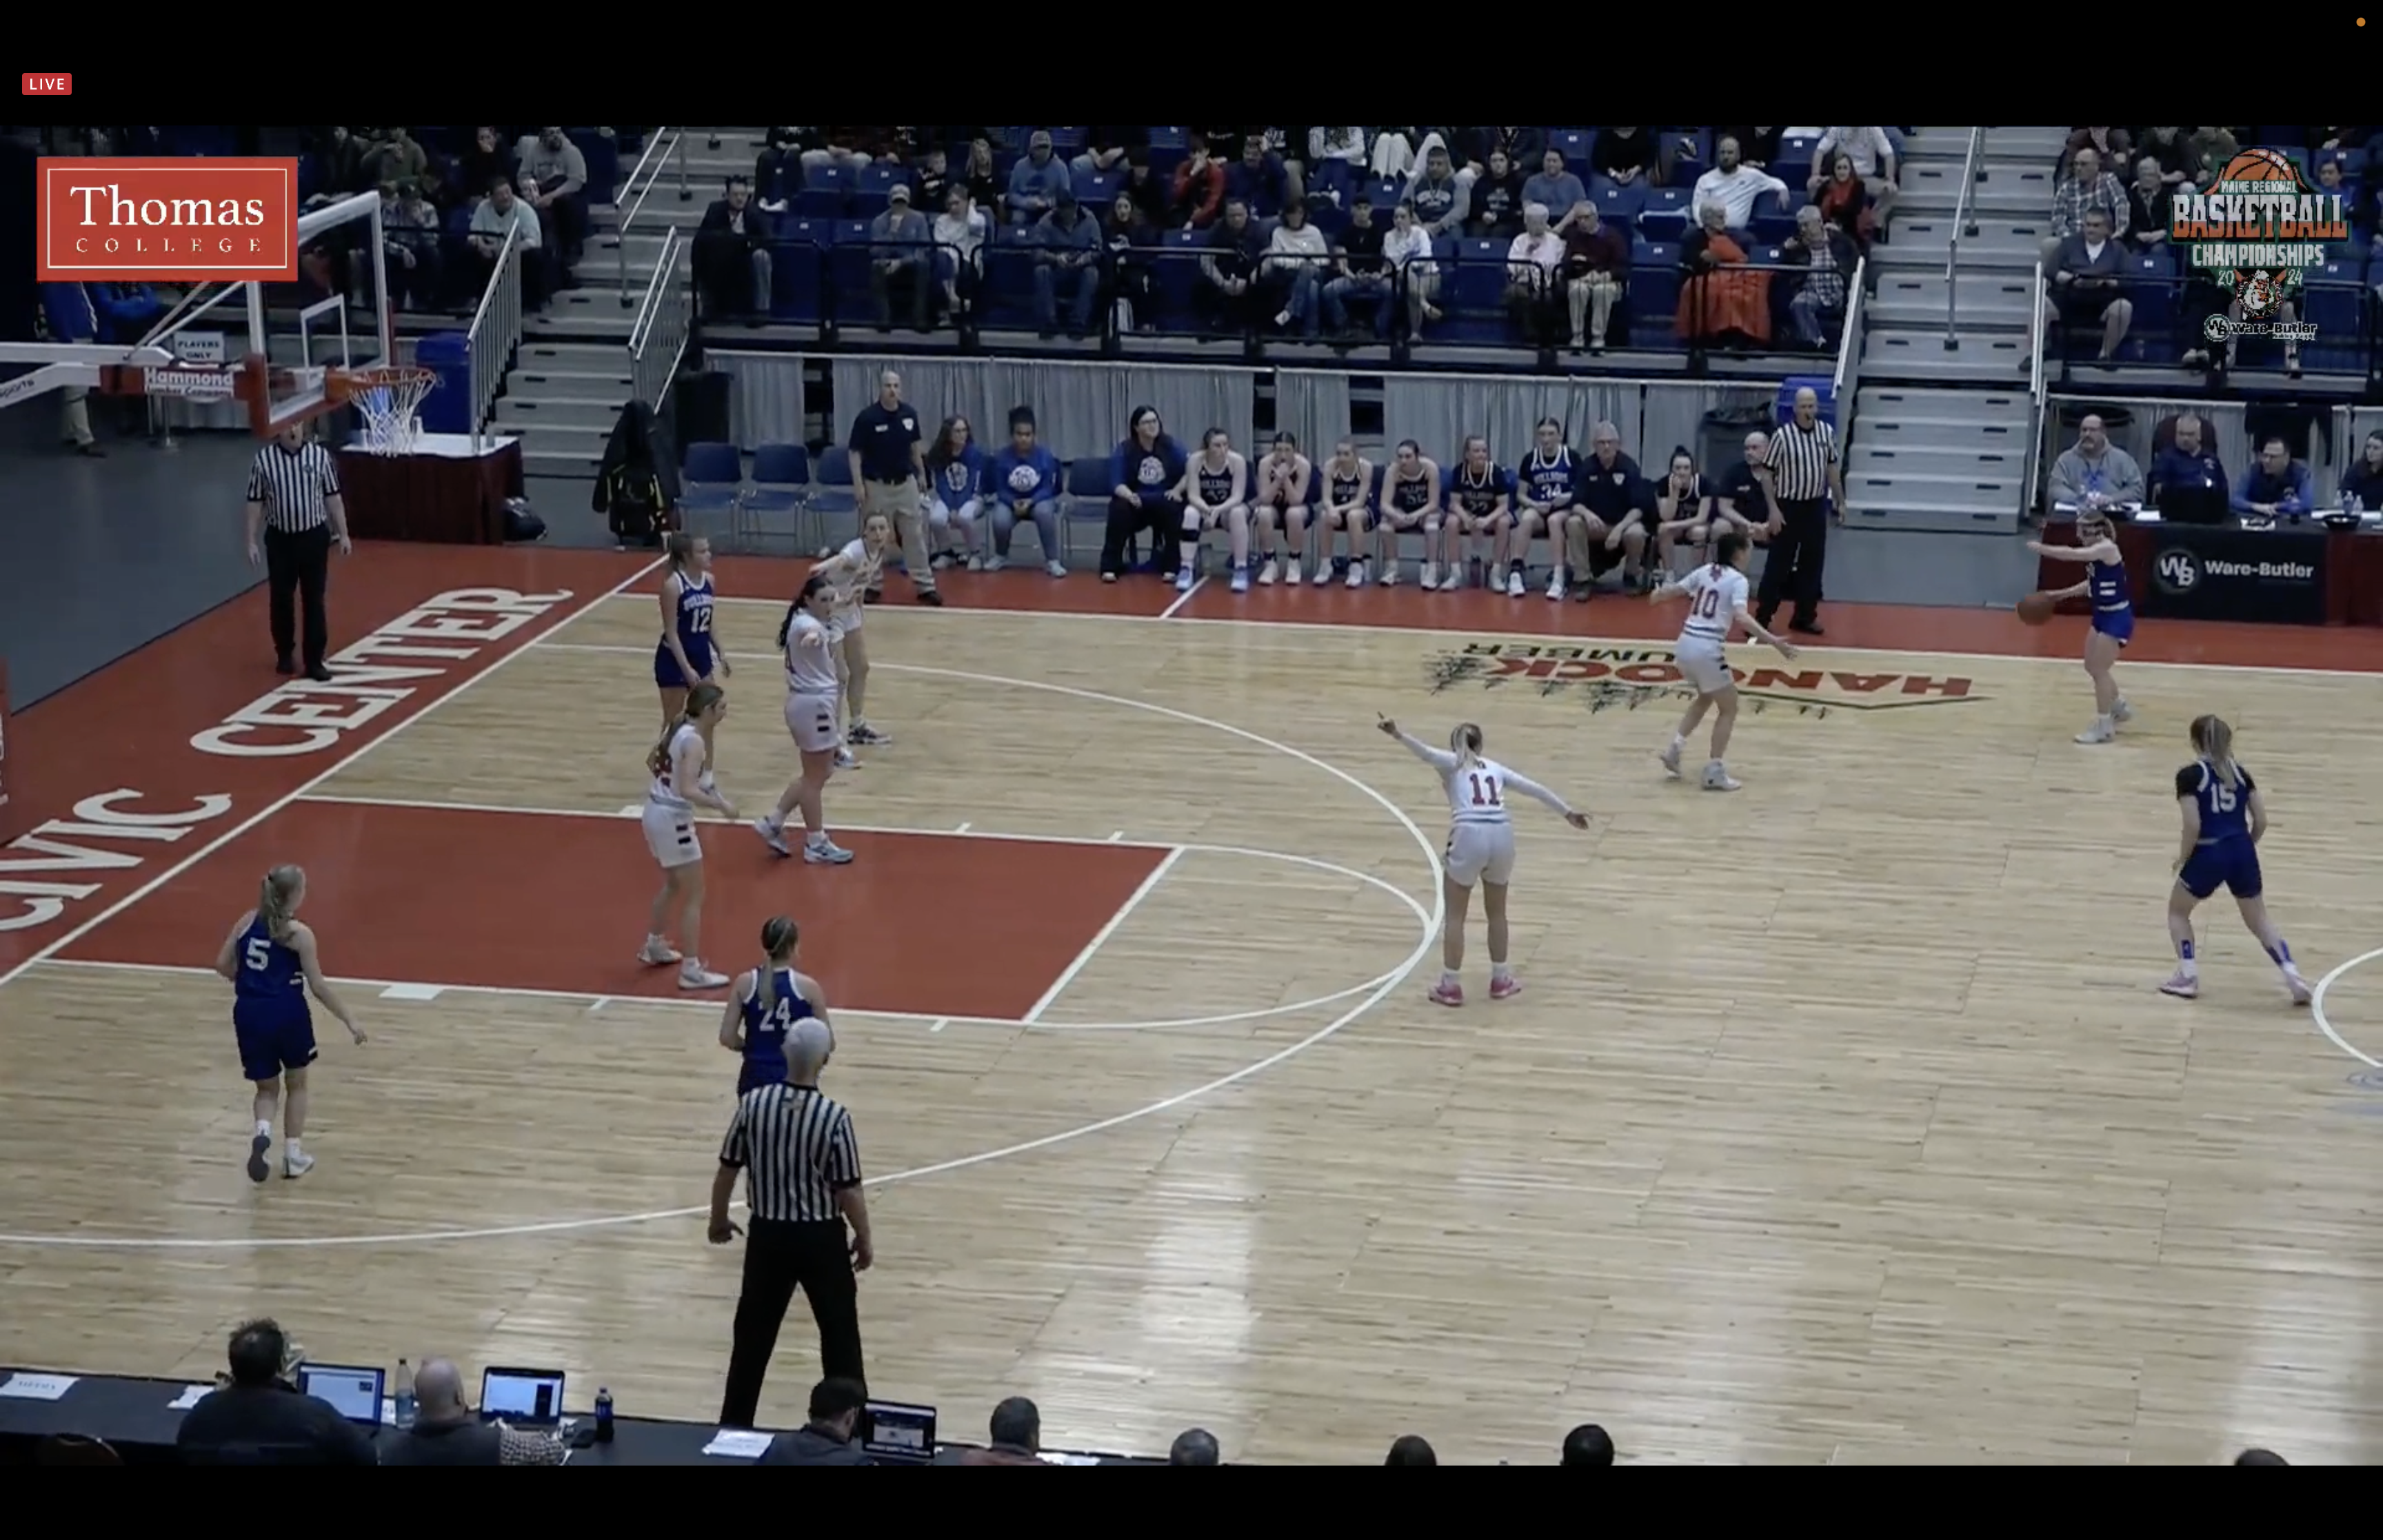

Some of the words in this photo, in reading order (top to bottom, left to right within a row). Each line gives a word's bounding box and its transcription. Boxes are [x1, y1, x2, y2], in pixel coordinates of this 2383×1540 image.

[177, 341, 220, 349] PLAYERS
[185, 351, 212, 359] ONLY
[143, 366, 234, 387] Hammond
[2160, 556, 2195, 586] WB
[2205, 560, 2315, 578] Ware-Butler
[1691, 586, 1720, 619] 10
[691, 607, 712, 633] 12
[1462, 644, 1676, 662] UMBER
[190, 587, 574, 756] CENTER
[1484, 657, 1972, 696] HANOCK
[1469, 773, 1500, 805] 11
[2211, 782, 2237, 813] 15
[245, 937, 271, 971] 5
[758, 997, 791, 1032] 24
